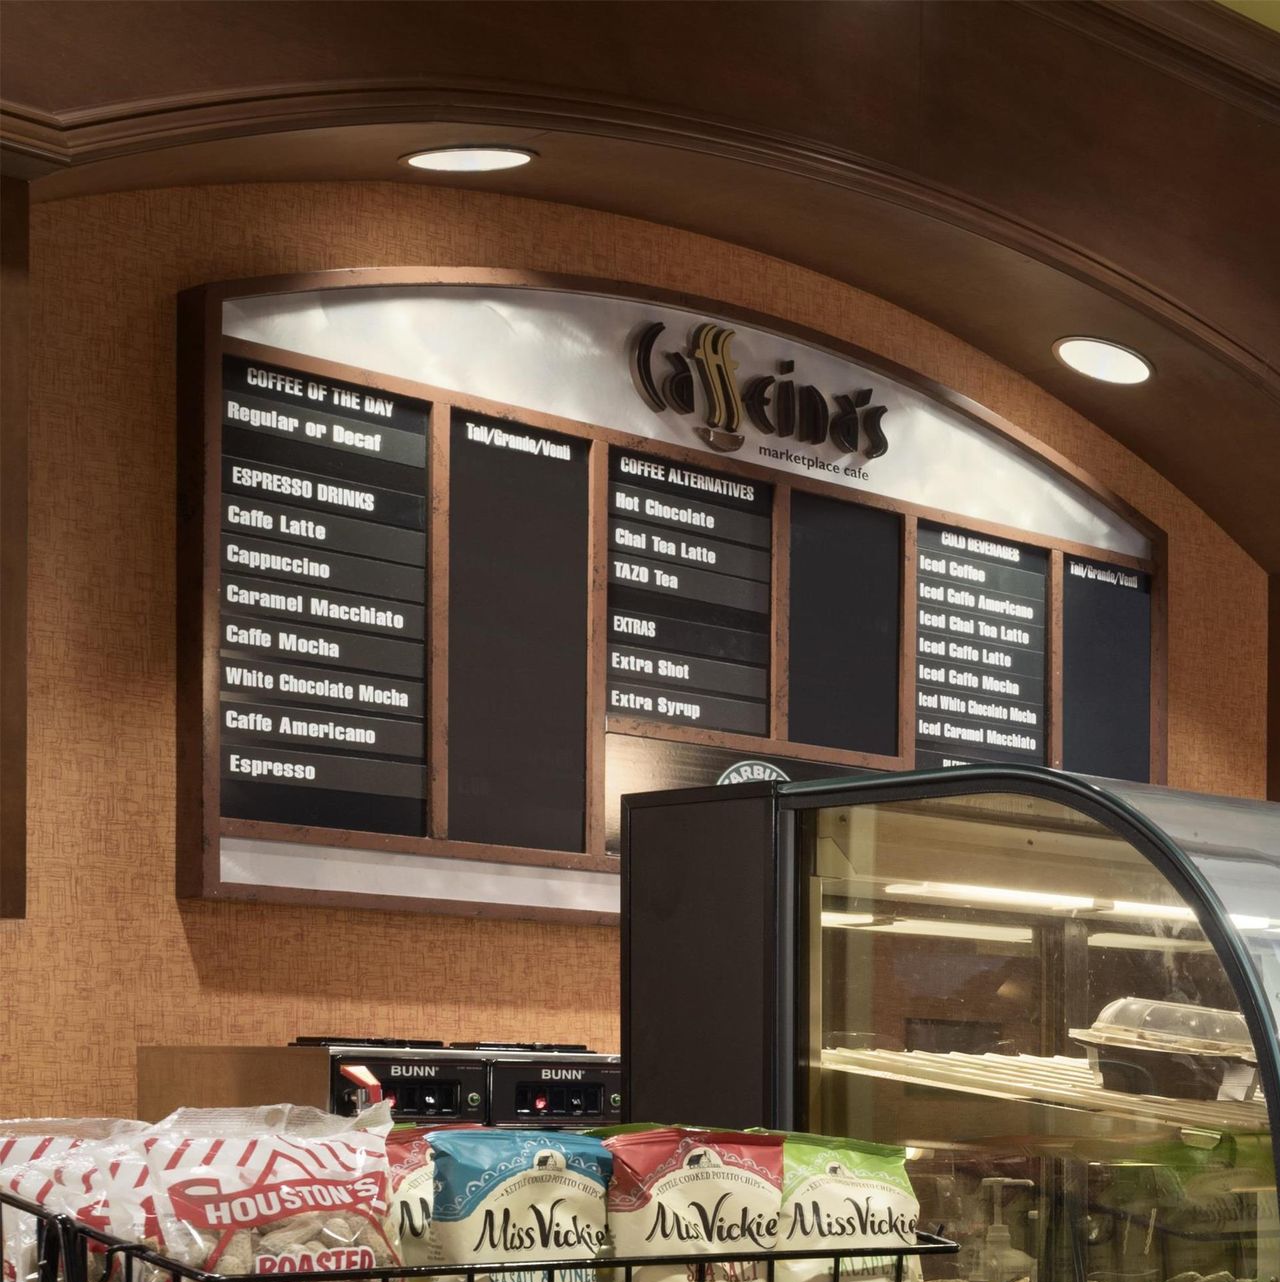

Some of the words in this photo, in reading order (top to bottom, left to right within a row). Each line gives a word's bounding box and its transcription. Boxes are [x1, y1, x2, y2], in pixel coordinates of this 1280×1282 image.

[247, 367, 303, 397] COFFEE
[307, 382, 328, 401] OF
[332, 387, 360, 410] THE
[364, 396, 394, 418] DAY
[227, 401, 299, 432] Regular
[305, 421, 327, 439] or
[333, 425, 382, 452] Decaf
[466, 422, 571, 461] Tall/Grande/Venti
[620, 456, 665, 481] COFFEE
[668, 468, 755, 502] ALTERNATIVES
[759, 444, 840, 475] marketplace
[843, 464, 870, 482] cafe
[232, 466, 312, 498] ESPRESSO
[317, 483, 375, 512] DRINKS
[228, 505, 273, 530] Caffe
[280, 515, 326, 541] Latte
[615, 491, 639, 513] Hot
[645, 499, 715, 530] Chocolate
[227, 544, 330, 579] Cappuccino
[615, 528, 647, 549] Chai
[651, 535, 676, 557] Tea
[681, 542, 717, 565] Latte
[941, 531, 967, 551] COLD
[967, 535, 1020, 563] BEVERAGES
[614, 561, 649, 584] TAZO
[654, 569, 679, 590] Tea
[919, 555, 946, 574] Iced
[949, 561, 986, 583] Coffee
[226, 584, 303, 613] Caramel
[310, 597, 404, 630] Macchiato
[919, 582, 944, 601] Iced
[947, 588, 975, 608] Caffe
[978, 591, 1034, 620] Americano
[226, 624, 272, 648] Caffe
[278, 632, 340, 658] Mocha
[613, 615, 656, 638] EXTRAS
[919, 610, 946, 629] Iced
[949, 616, 974, 634] Chai
[978, 621, 998, 639] Tea
[1000, 625, 1030, 645] Latte
[611, 652, 653, 674] Extra
[658, 658, 690, 680] Shot
[919, 637, 946, 656] Iced
[949, 643, 979, 662] Caffe
[982, 649, 1012, 668] Latte
[225, 666, 274, 690] White
[279, 673, 354, 700] Chocolate
[358, 684, 409, 708] Mocha
[919, 664, 945, 683] Iced
[948, 669, 979, 689] Caffe
[982, 675, 1020, 696] Mocha
[611, 689, 653, 712] Extra
[657, 696, 701, 720] Syrup
[918, 692, 938, 709] Iced
[939, 695, 966, 714] White
[968, 700, 1008, 721] Chocolate
[1009, 707, 1037, 726] Mocha
[225, 710, 273, 732] Caffe
[279, 716, 376, 745] Americano
[918, 719, 941, 737] Iced
[944, 723, 984, 744] Caramel
[986, 728, 1036, 751] Macchiato
[229, 754, 316, 780] Espresso
[390, 1065, 438, 1078] BUNN
[541, 1069, 584, 1081] BUNN
[552, 1174, 577, 1189] POTATO
[577, 1182, 600, 1198] CHIPS
[679, 1171, 711, 1185] COOKED
[711, 1171, 740, 1182] POTATO
[740, 1175, 761, 1190] CHIPS
[204, 1177, 380, 1225] HOUSTON'S
[473, 1207, 536, 1252] Miss
[786, 1200, 857, 1240] Miss
[258, 1248, 375, 1275] ROASTED
